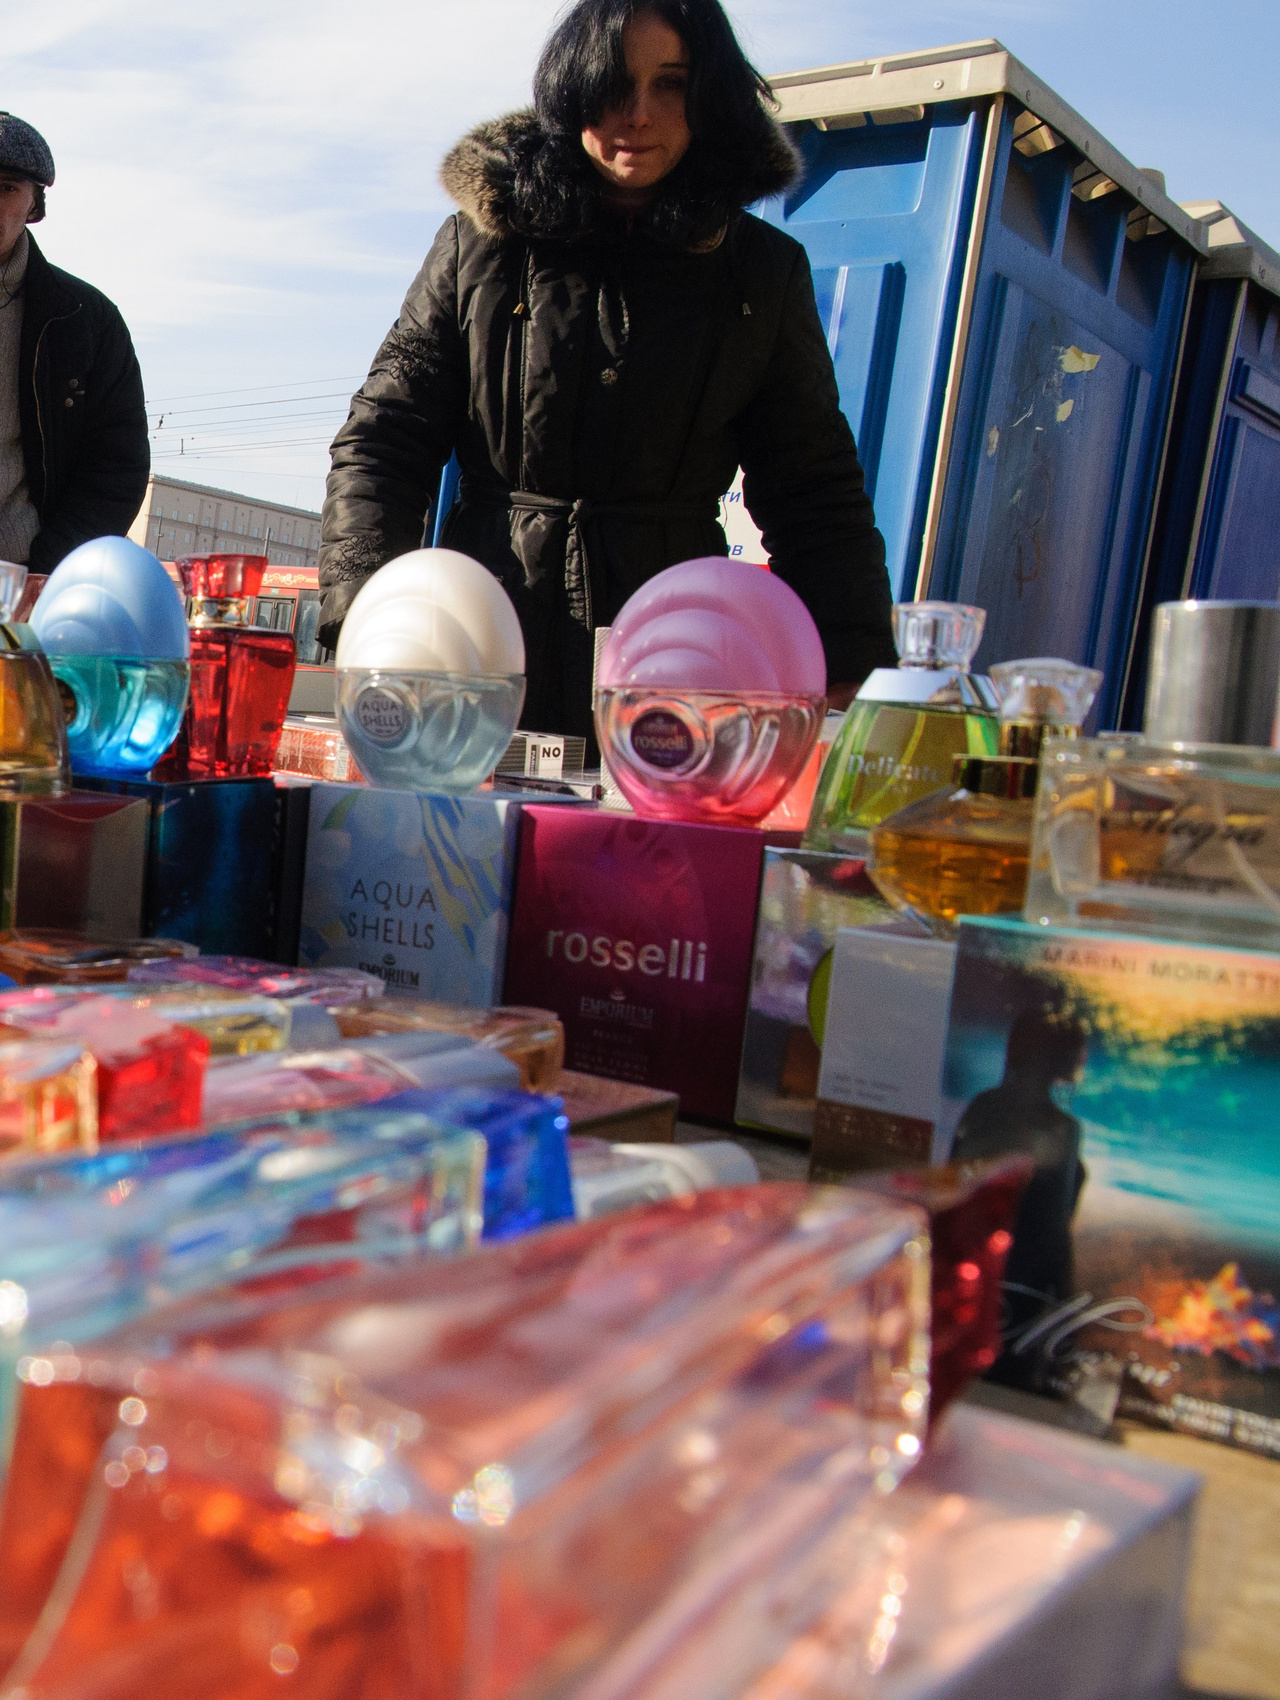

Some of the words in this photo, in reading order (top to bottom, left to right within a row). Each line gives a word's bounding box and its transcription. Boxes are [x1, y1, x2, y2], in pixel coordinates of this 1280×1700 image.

[541, 746, 561, 758] NO
[350, 878, 437, 912] AQUA
[344, 911, 436, 951] SHELLS
[545, 929, 708, 983] rosselli
